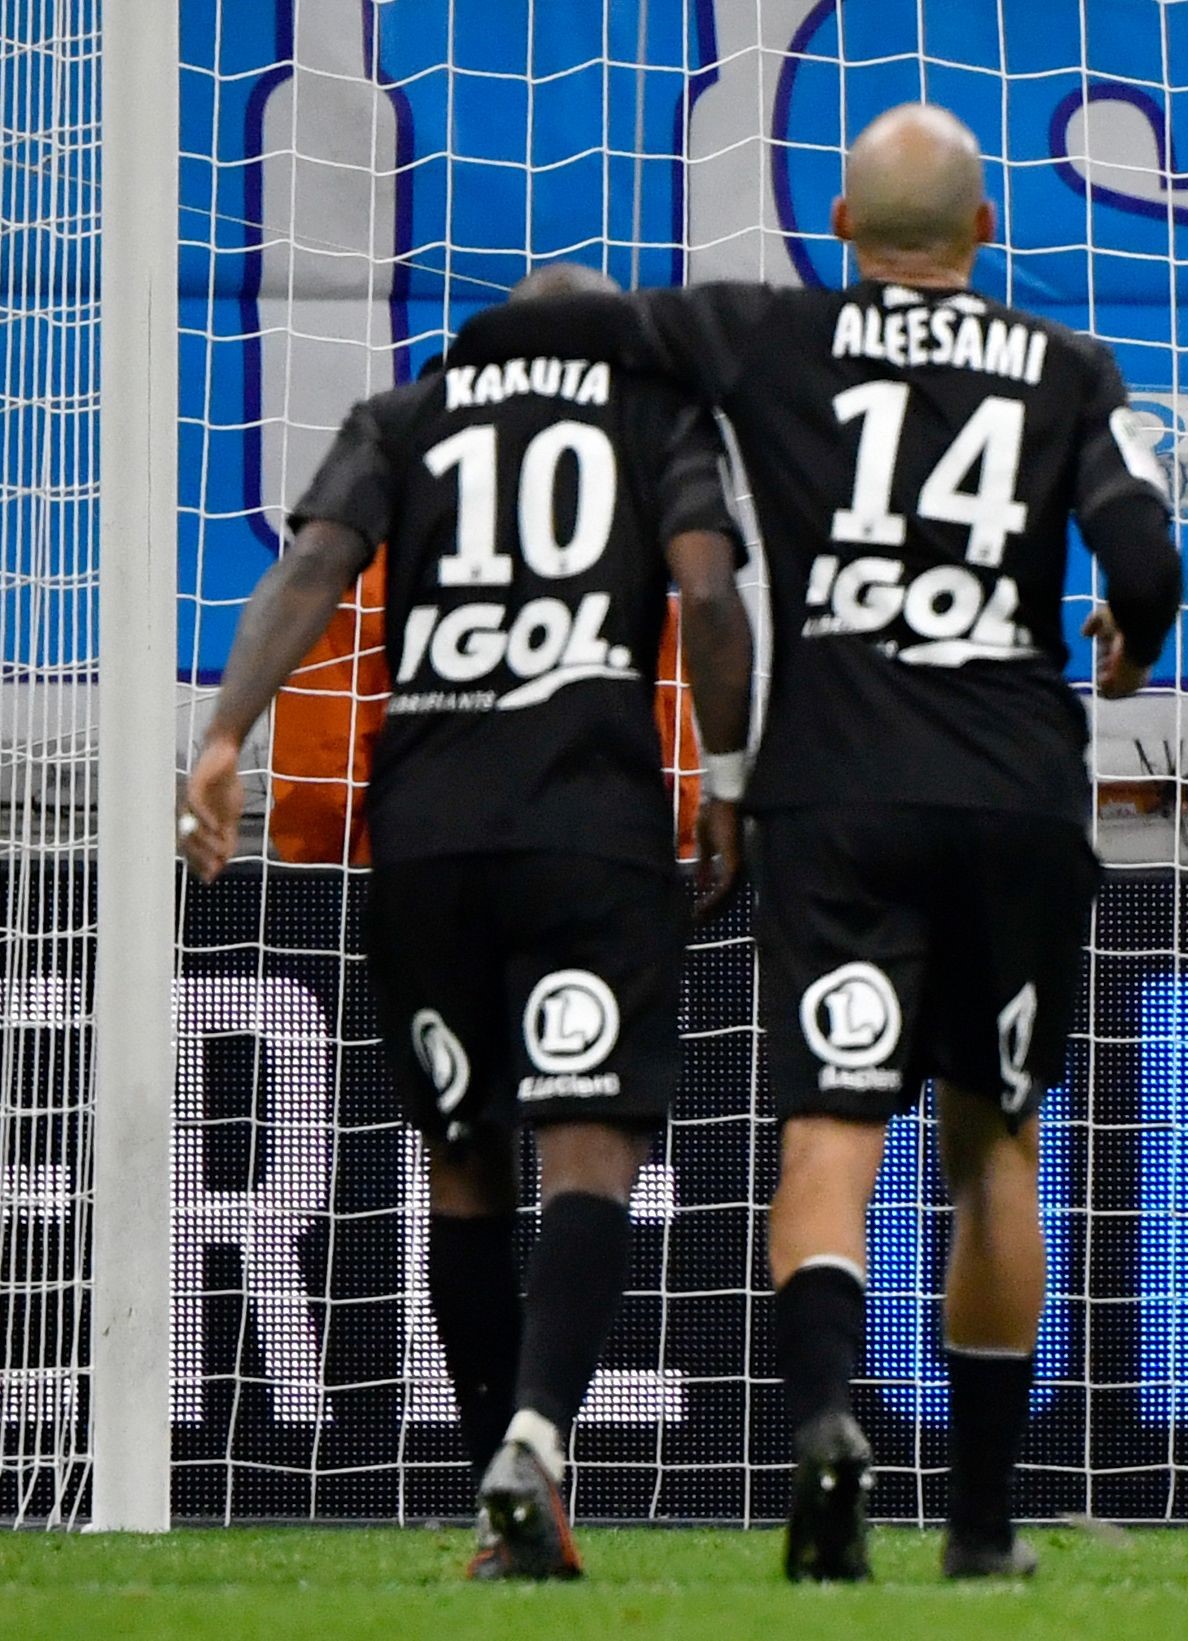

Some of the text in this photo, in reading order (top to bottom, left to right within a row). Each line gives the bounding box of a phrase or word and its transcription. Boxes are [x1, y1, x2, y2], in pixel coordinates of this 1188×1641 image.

[445, 356, 610, 412] KAKUTA
[832, 302, 1047, 385] ALEESAMI
[422, 419, 617, 586] 10
[832, 379, 1028, 568] 14
